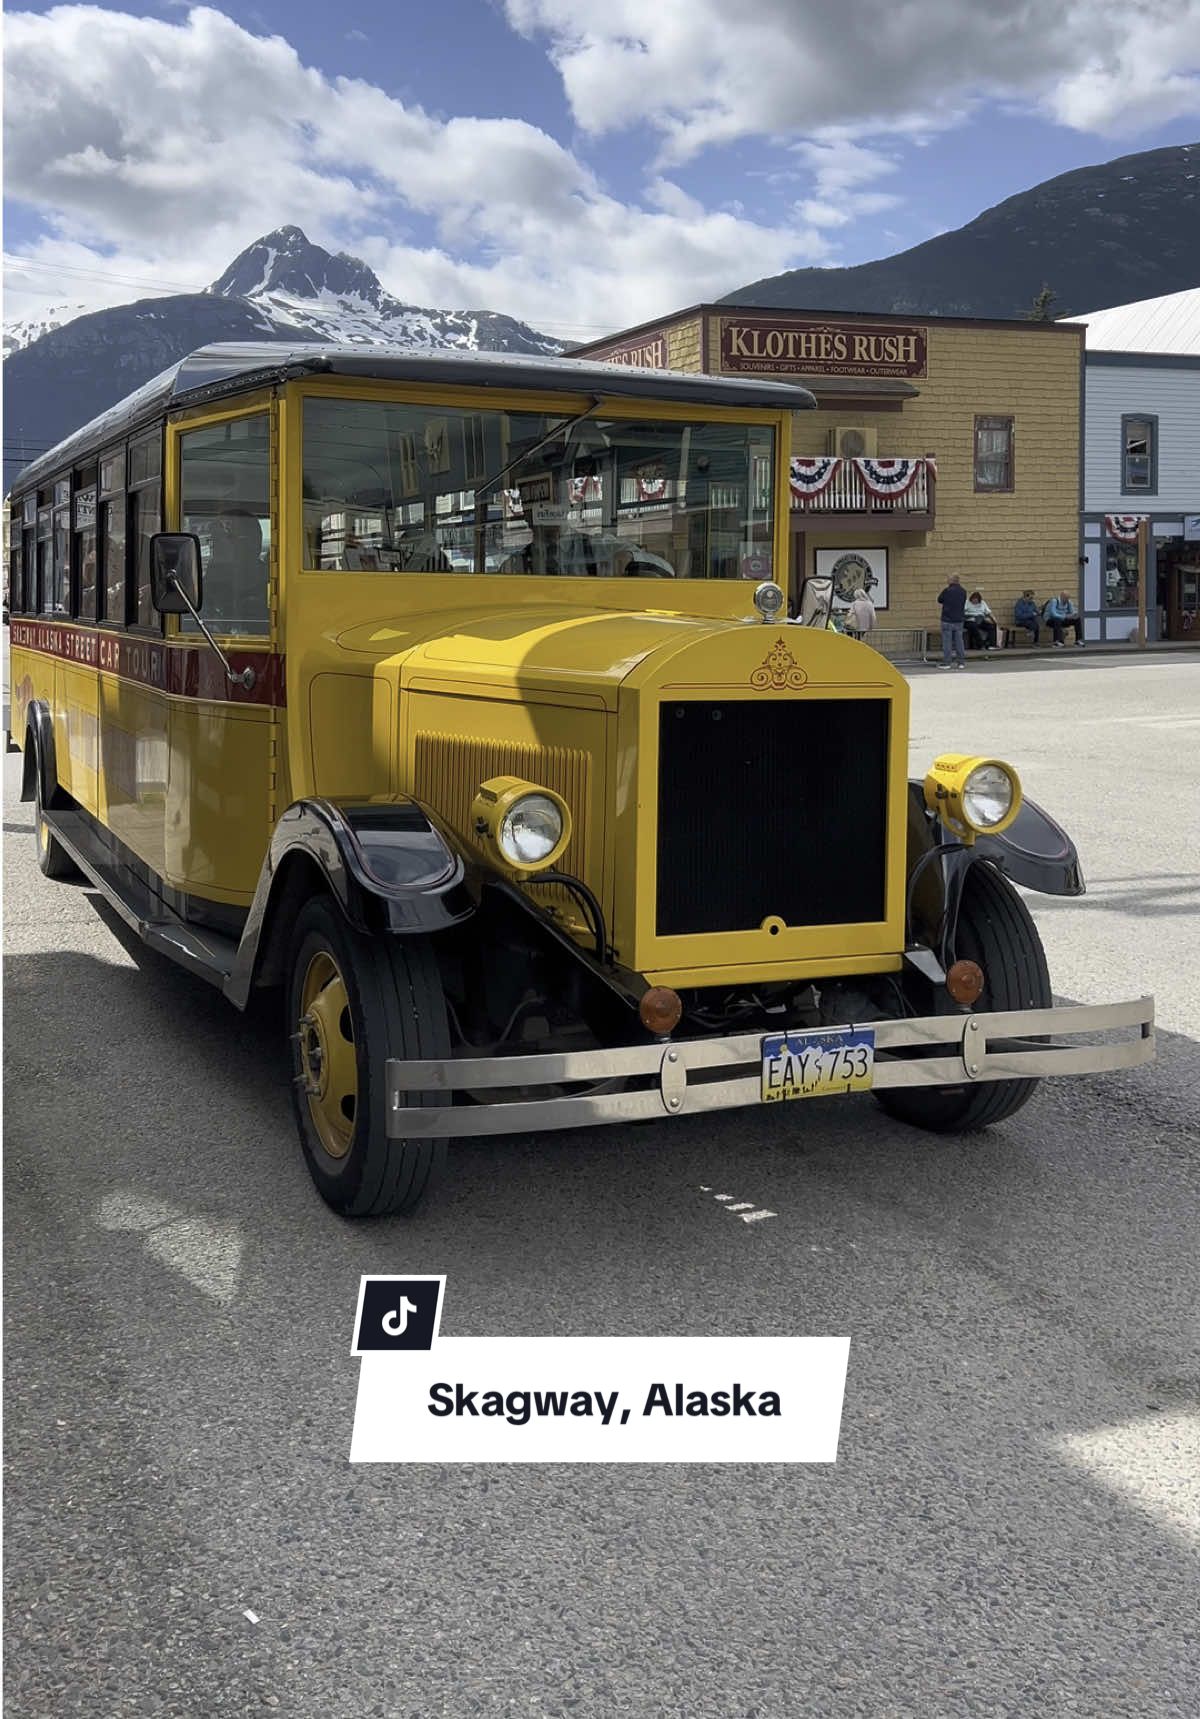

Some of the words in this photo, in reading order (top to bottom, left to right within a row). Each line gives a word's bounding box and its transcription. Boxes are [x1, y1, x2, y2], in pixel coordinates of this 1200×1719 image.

[729, 327, 848, 361] KLOTHES
[853, 335, 917, 363] RUSH
[741, 362, 775, 372] SOUVENIRS
[779, 363, 797, 373] GIFTS
[801, 364, 826, 374] APPAREL
[830, 366, 866, 376] FOOTWEAR
[869, 367, 909, 378] OUTERWEAR
[66, 633, 97, 664] STREET
[100, 640, 120, 670] CAR
[768, 1053, 810, 1089] EAY
[828, 1047, 868, 1082] 753
